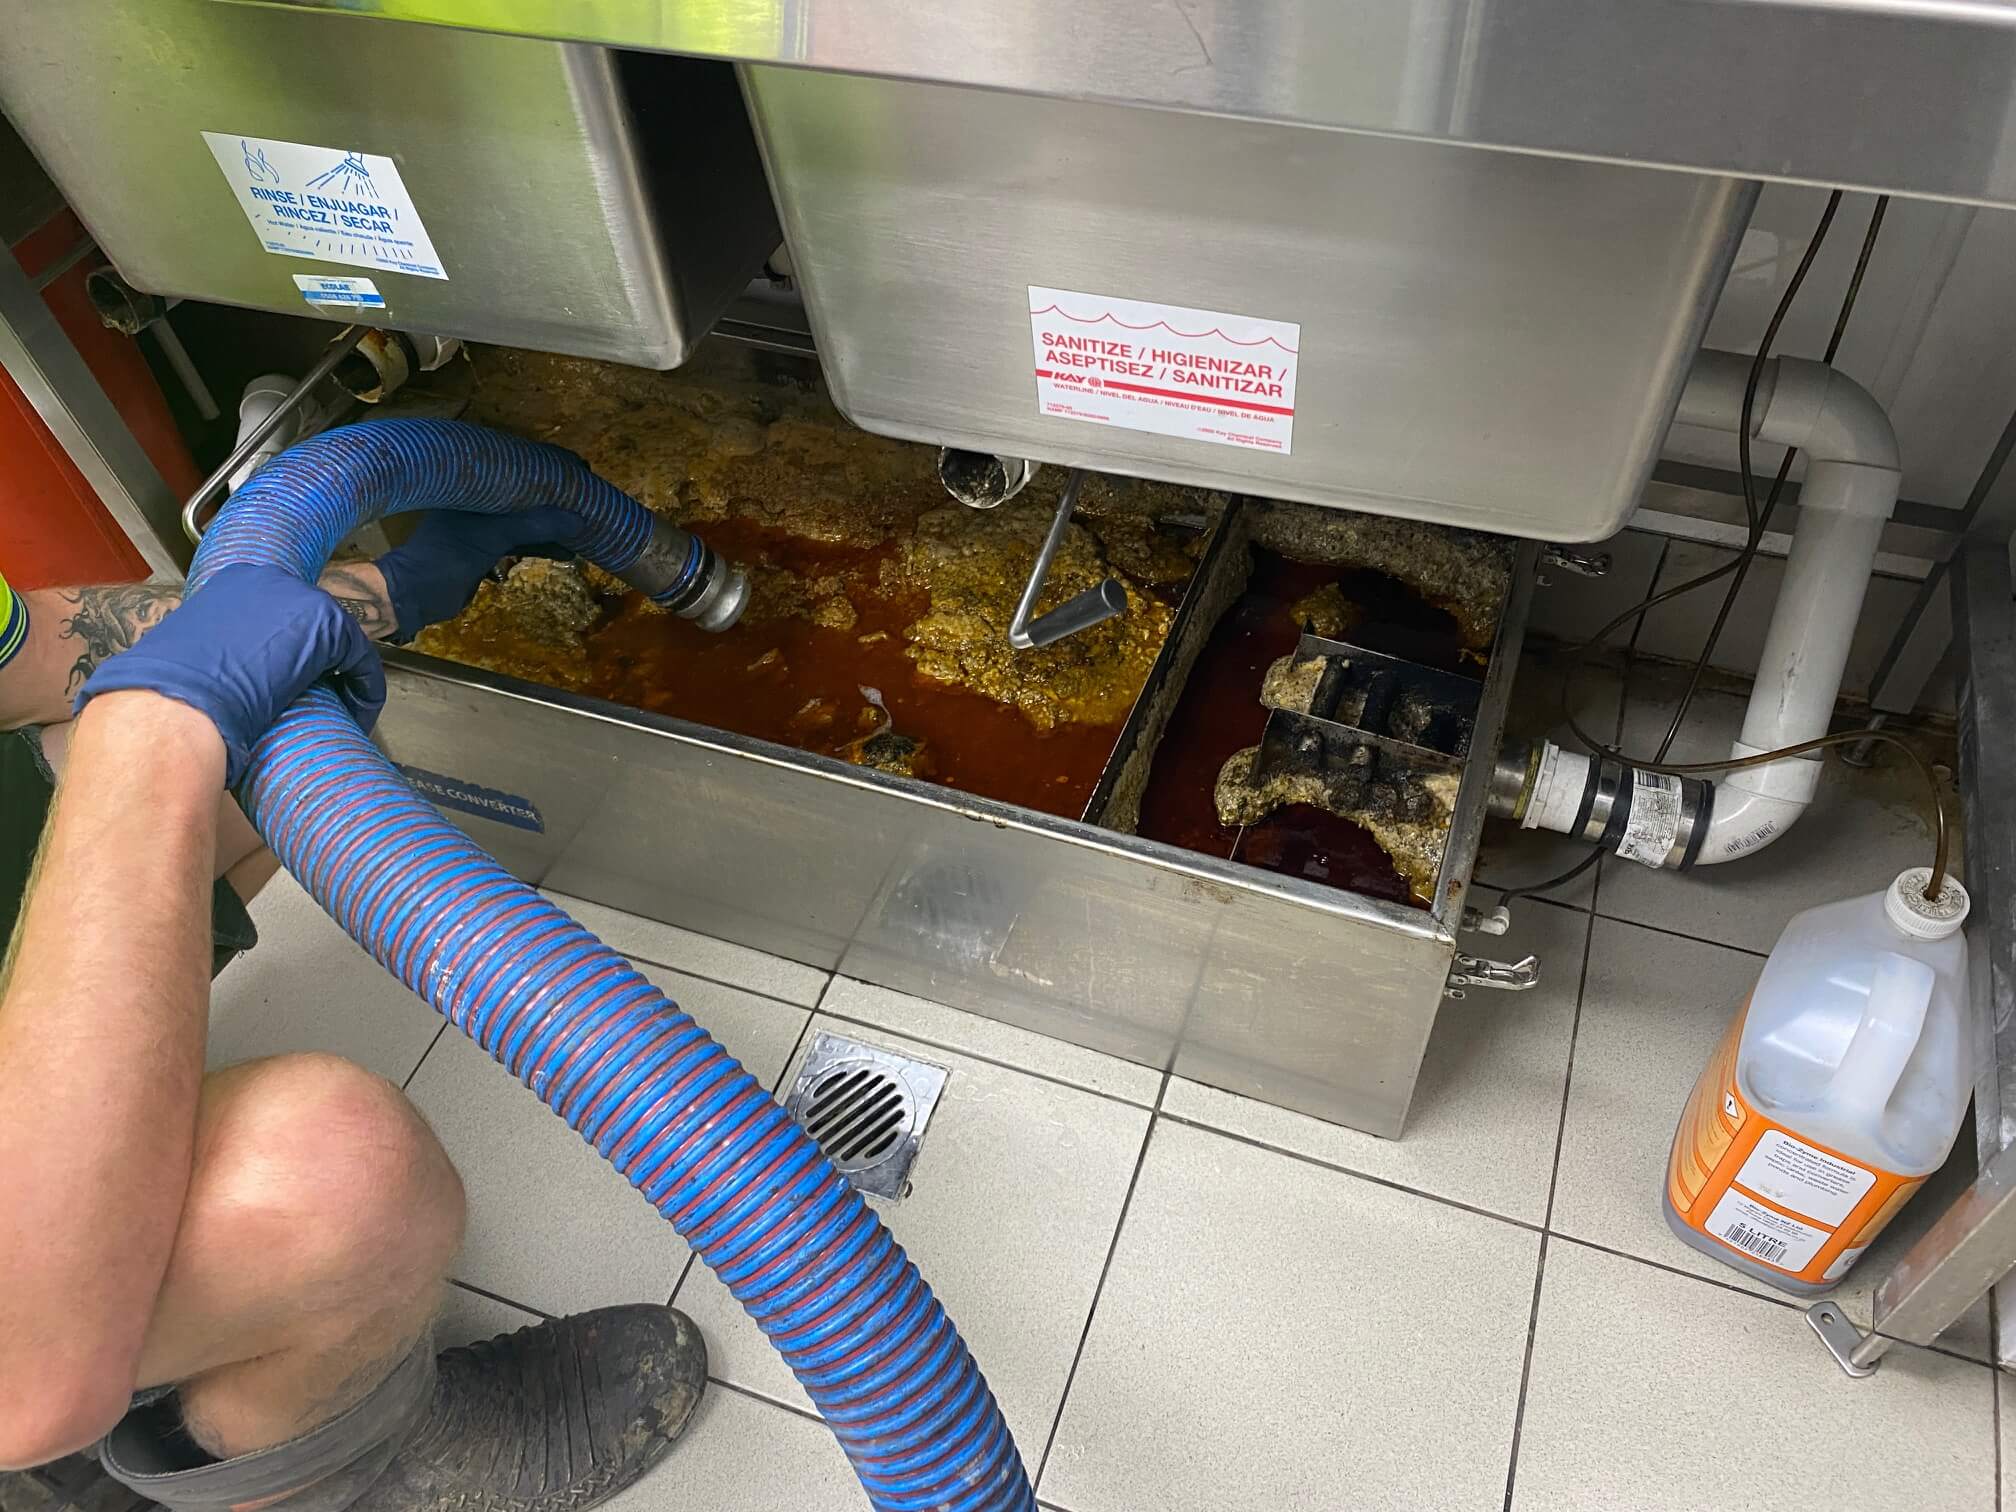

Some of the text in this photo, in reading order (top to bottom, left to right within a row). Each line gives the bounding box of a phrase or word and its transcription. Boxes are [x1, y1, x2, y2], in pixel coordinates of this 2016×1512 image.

[250, 186, 298, 205] RINSE
[306, 194, 391, 219] ENJUAGAR
[272, 204, 331, 224] RINCEZ
[341, 214, 393, 234] SECAR
[1041, 332, 1287, 382] SANITIZE / HIGIENIZAR /
[1045, 350, 1283, 398] ASEPTISEZ / SANITIZAR
[1054, 372, 1086, 383] KAY
[1053, 383, 1094, 395] WATERLINE
[1100, 390, 1121, 399] NIVEL
[1138, 396, 1159, 404] AGUA
[1165, 400, 1189, 410] NIVEAU
[1190, 404, 1212, 414] D'EAU
[1217, 409, 1240, 418] NIVEL
[1241, 412, 1251, 420] DE
[407, 777, 540, 823] EASE CONVERTER
[1783, 1140, 1856, 1175] Bio-Zyme Industrial
[1749, 1227, 1788, 1247] LITRE
